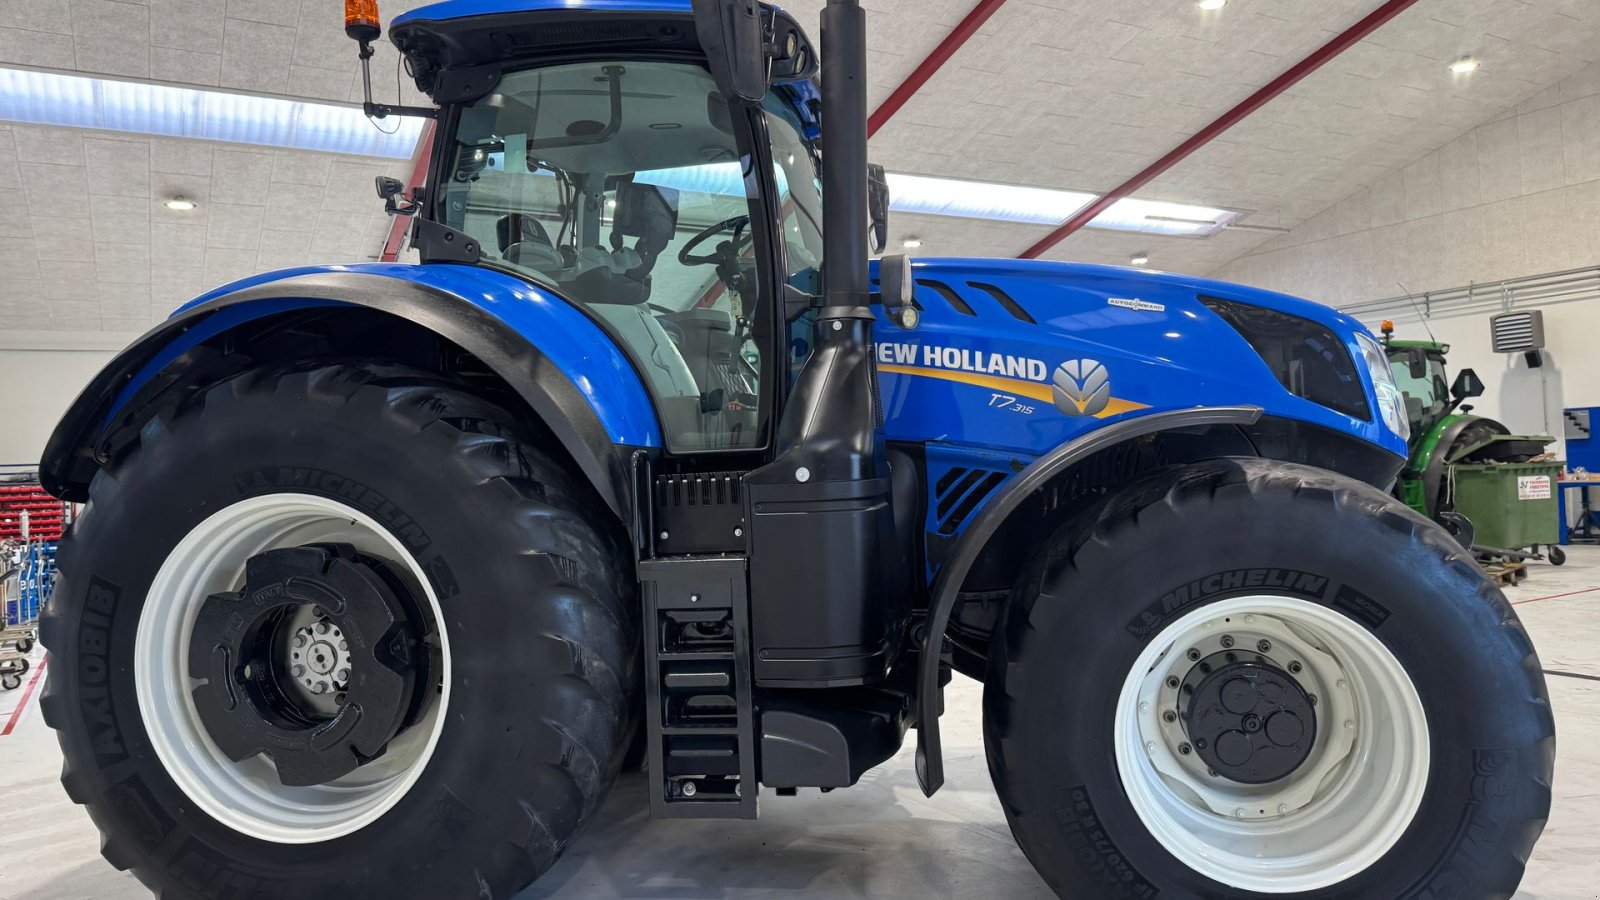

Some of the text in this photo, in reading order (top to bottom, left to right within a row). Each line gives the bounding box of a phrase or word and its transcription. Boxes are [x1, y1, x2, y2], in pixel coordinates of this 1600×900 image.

[874, 342, 1048, 382] EW HOLLAND
[277, 466, 433, 556] MICHELIN
[1160, 567, 1329, 612] MICHELIN
[79, 582, 127, 762] AXIOBIB
